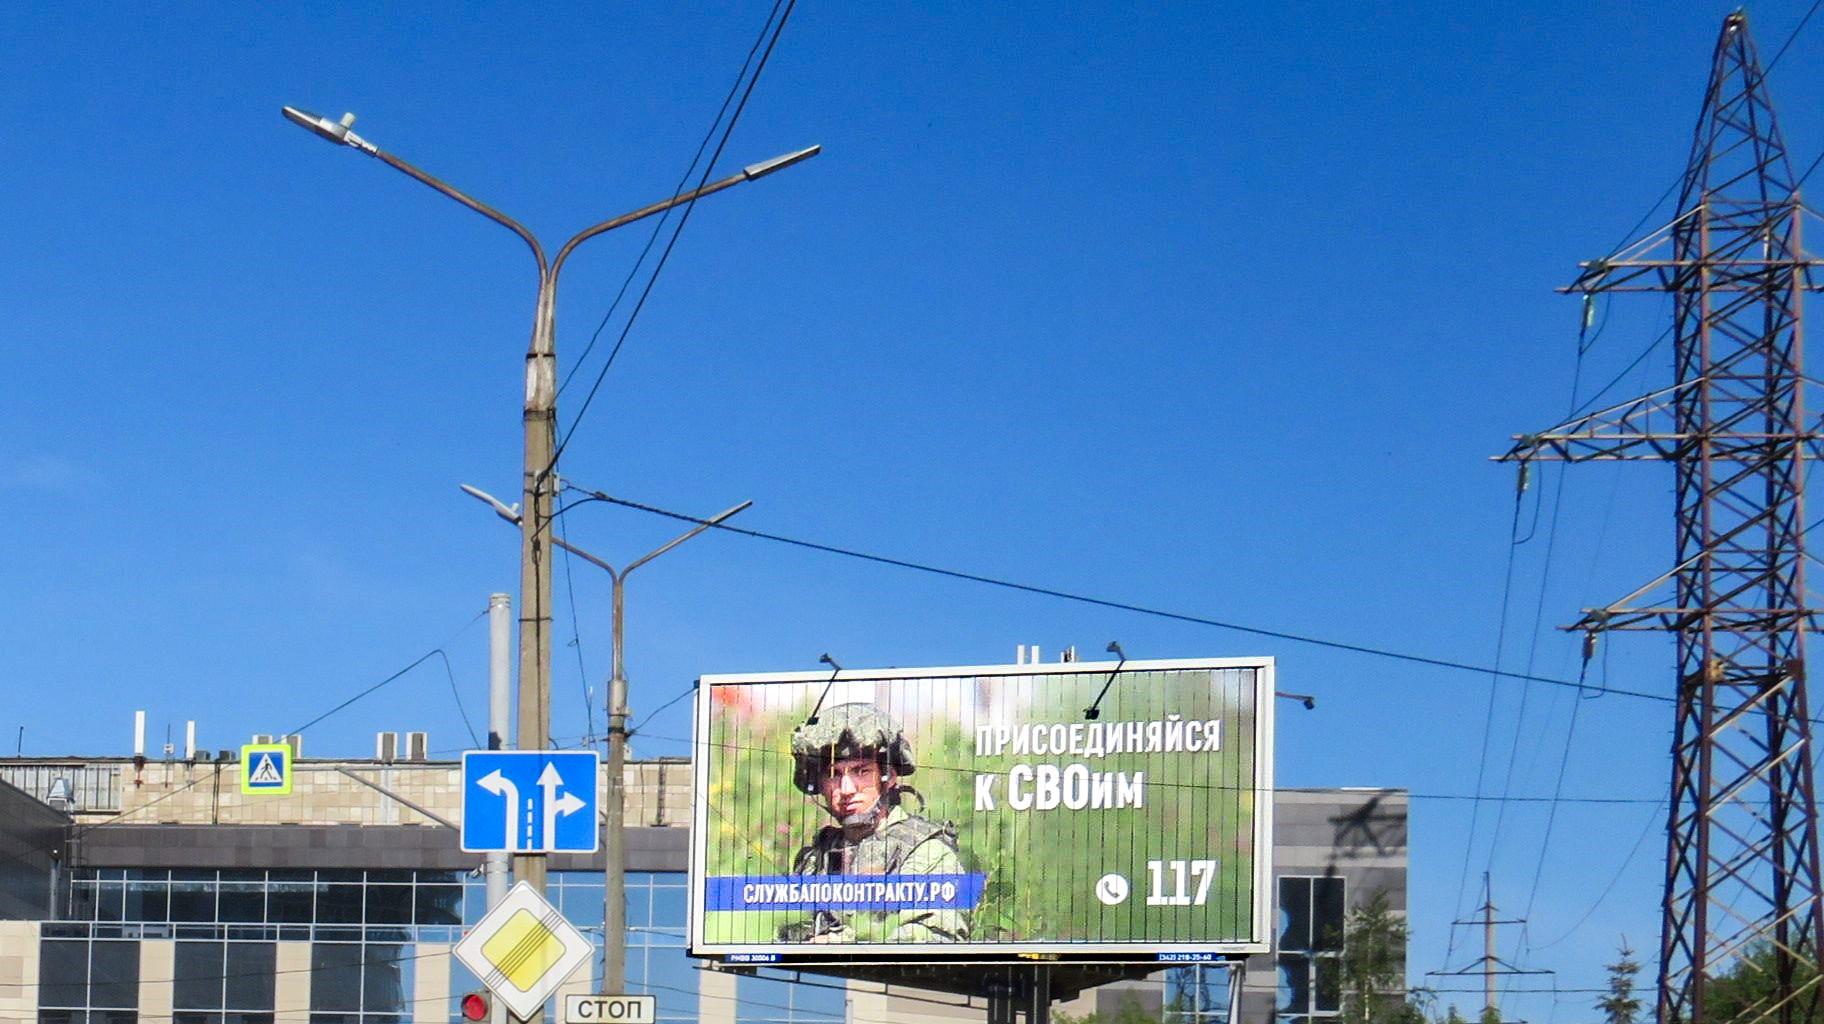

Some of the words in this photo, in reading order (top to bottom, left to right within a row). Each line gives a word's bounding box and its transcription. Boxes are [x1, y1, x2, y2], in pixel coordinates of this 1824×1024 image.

[975, 714, 1221, 758] ПРИСОЕДИНЯЙСЯ
[743, 881, 956, 903] СЛУЖБАПОКОНТРАКТУ.РФ
[1147, 860, 1217, 906] 117
[578, 1000, 641, 1018] СТОП
